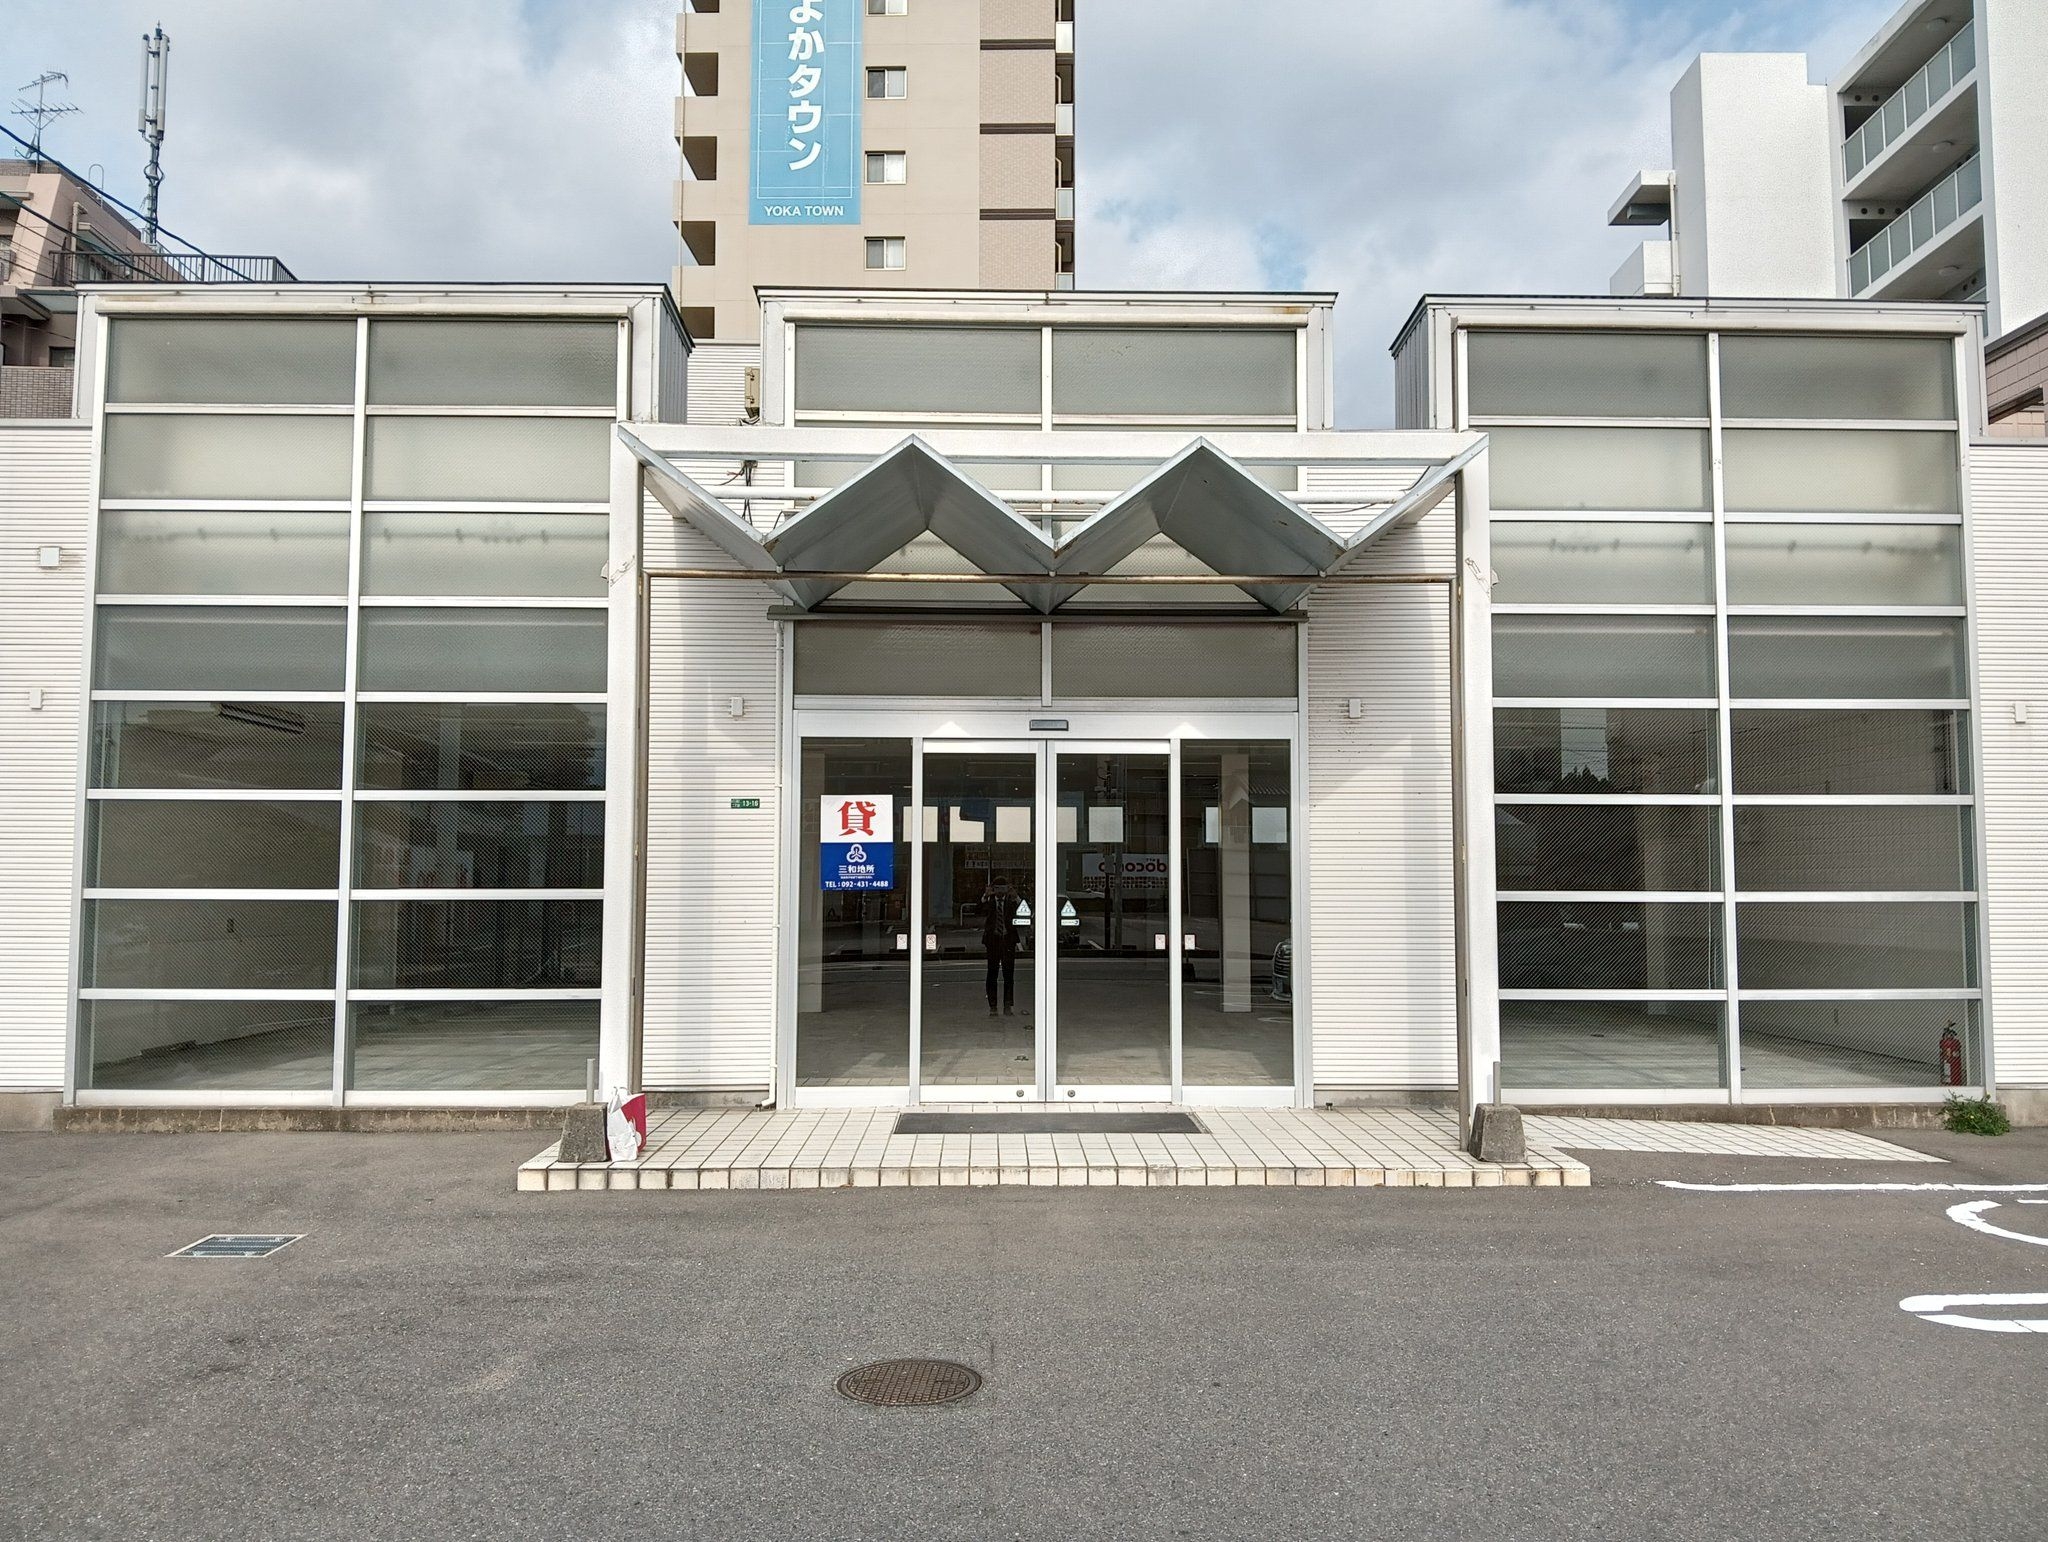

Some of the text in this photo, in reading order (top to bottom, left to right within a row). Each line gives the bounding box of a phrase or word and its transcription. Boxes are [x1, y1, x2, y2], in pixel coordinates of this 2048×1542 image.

[788, 0, 825, 170] よかタウン
[764, 205, 844, 216] YOKA TOWN
[837, 801, 877, 836] 貸
[838, 864, 875, 874] 三和地所
